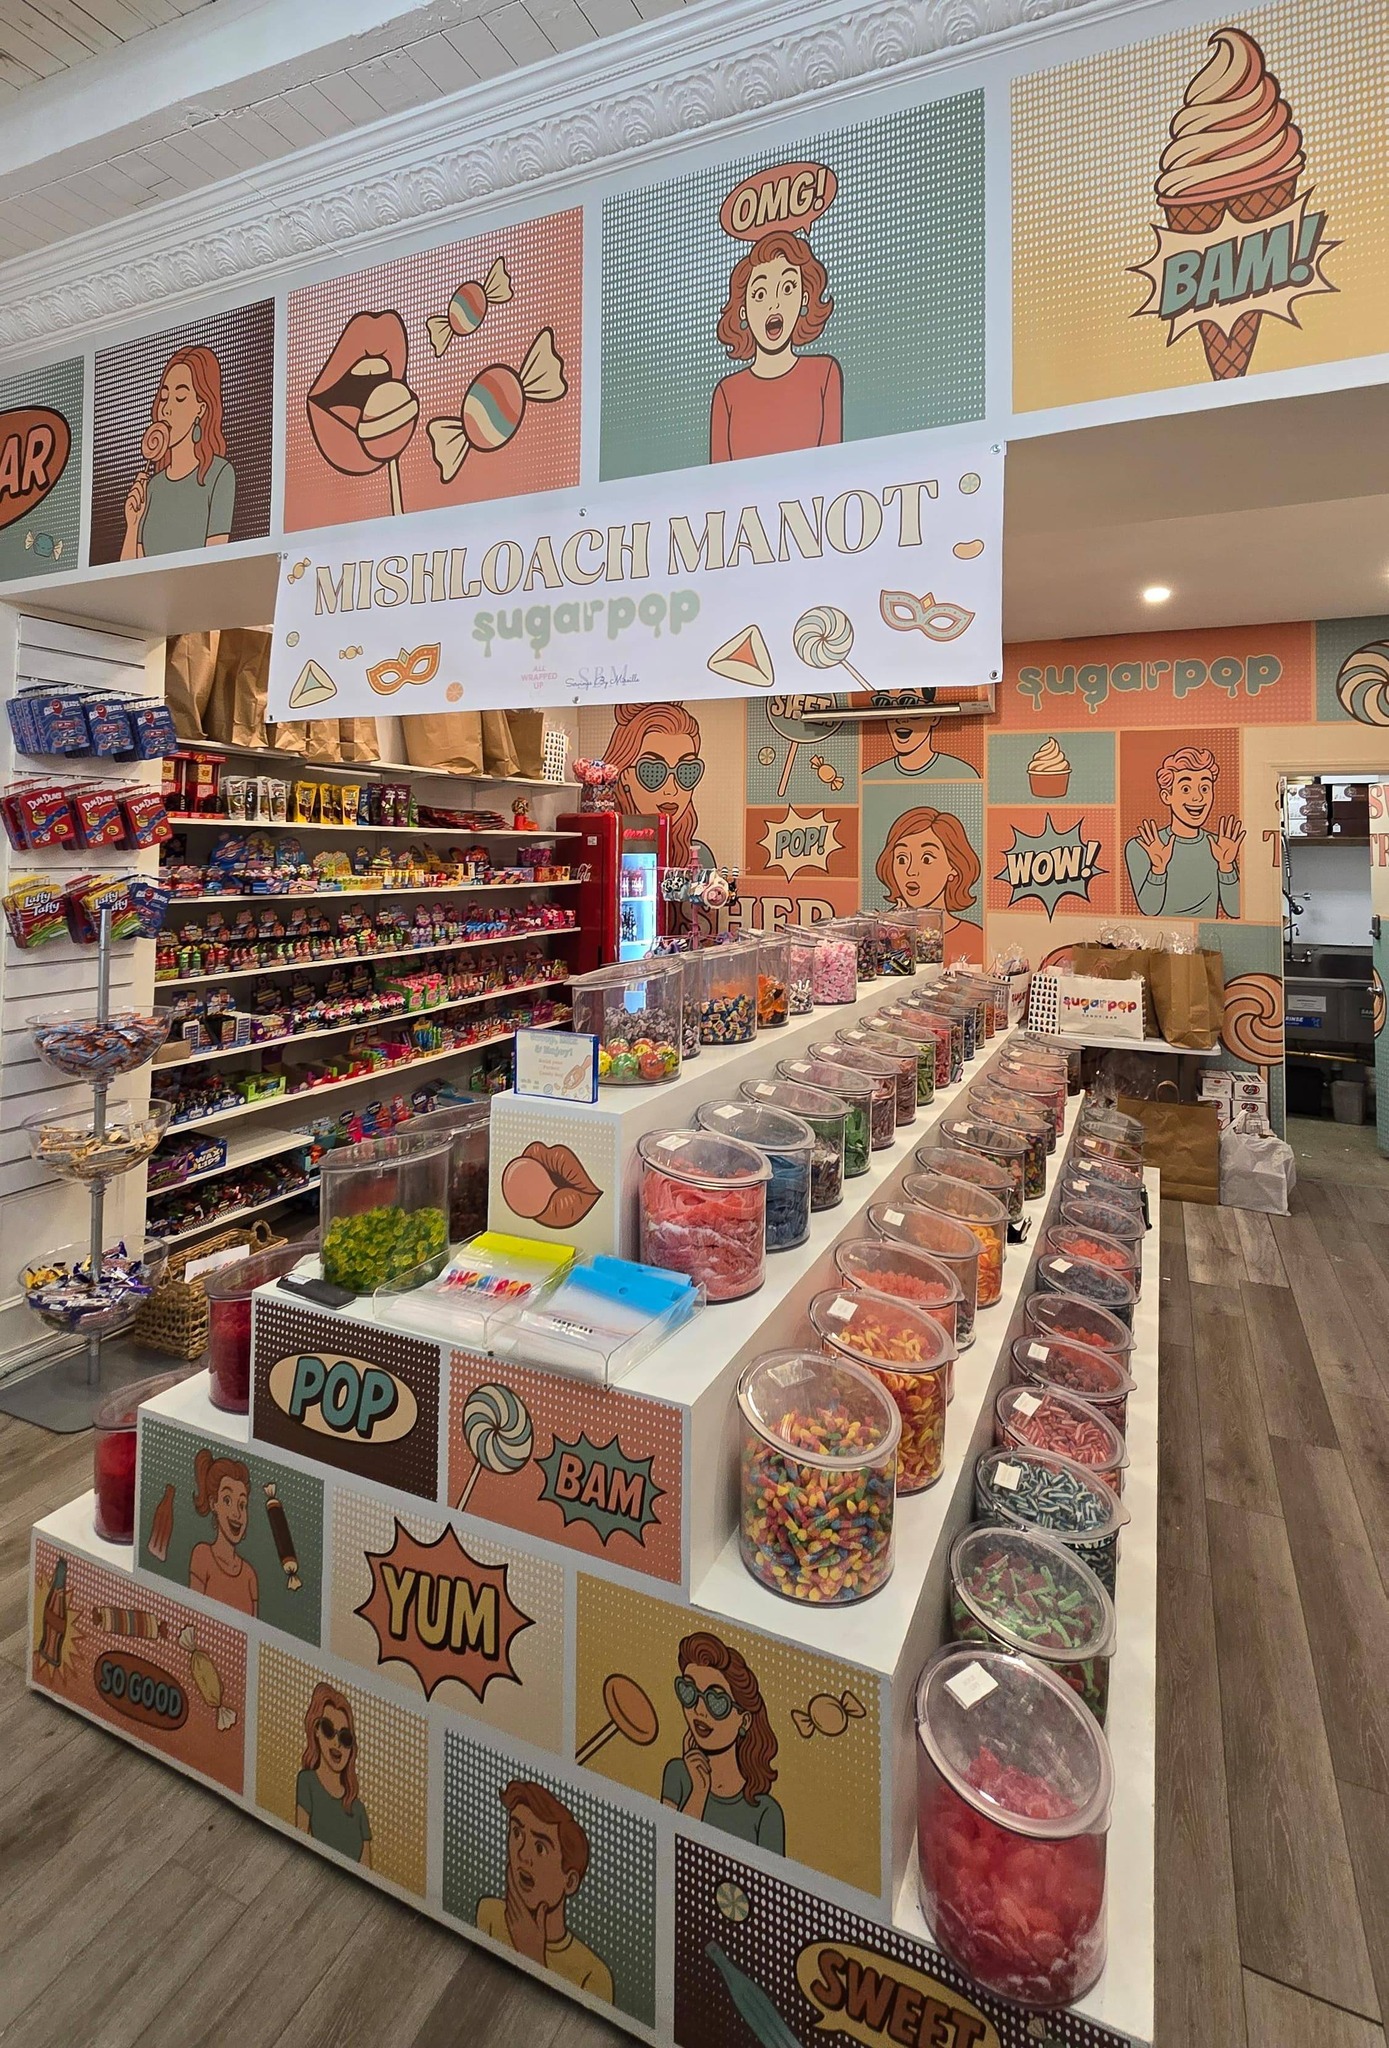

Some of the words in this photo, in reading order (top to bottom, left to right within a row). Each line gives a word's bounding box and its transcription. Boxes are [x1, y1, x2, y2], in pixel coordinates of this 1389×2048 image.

[731, 167, 828, 233] OMG!
[1158, 210, 1329, 321] BAM!
[315, 521, 651, 616] MISHLOACH
[667, 479, 939, 575] MANOT
[471, 588, 701, 660] sugarpop
[1016, 654, 1282, 714] sugarpop
[775, 825, 829, 860] POP!
[1006, 840, 1102, 889] WOW!
[1063, 996, 1137, 1013] sugarpop
[289, 1356, 399, 1440] POP
[554, 1451, 647, 1522] BAM
[380, 1562, 500, 1662] YUM
[100, 1659, 127, 1699] SO
[128, 1671, 184, 1719] GOOD
[809, 1948, 987, 2048] SWEET
